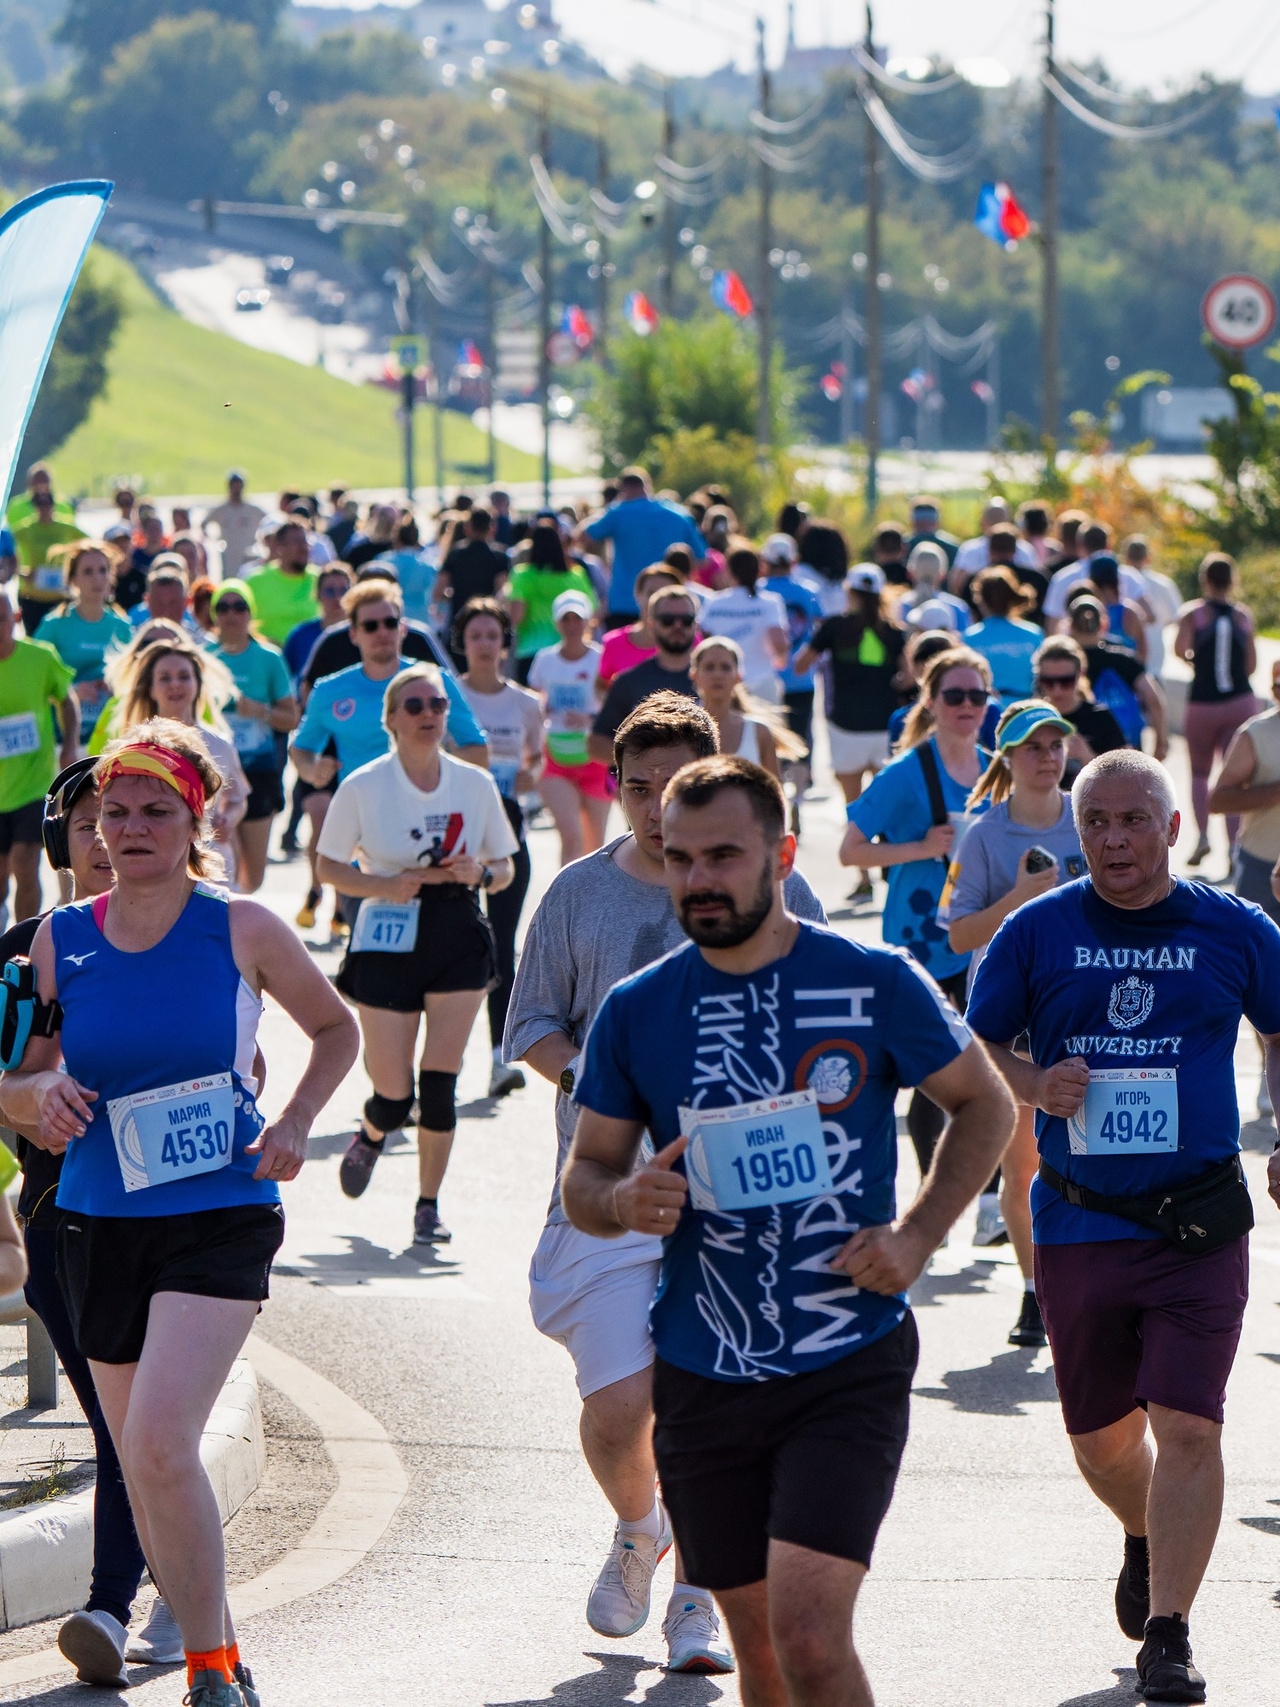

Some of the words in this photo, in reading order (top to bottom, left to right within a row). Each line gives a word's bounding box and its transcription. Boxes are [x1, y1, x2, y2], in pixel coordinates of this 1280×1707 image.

[1220, 297, 1260, 328] 40
[372, 922, 405, 945] 417
[1074, 945, 1197, 971] BAUMAN
[1064, 1036, 1182, 1056] UNIVERSITY
[1115, 1091, 1151, 1106] ИГОРЬ
[168, 1101, 212, 1126] МАРИЯ
[1100, 1109, 1168, 1143] 4942
[161, 1120, 230, 1168] 4530
[745, 1124, 785, 1148] ИВАН
[731, 1143, 816, 1195] 1950
